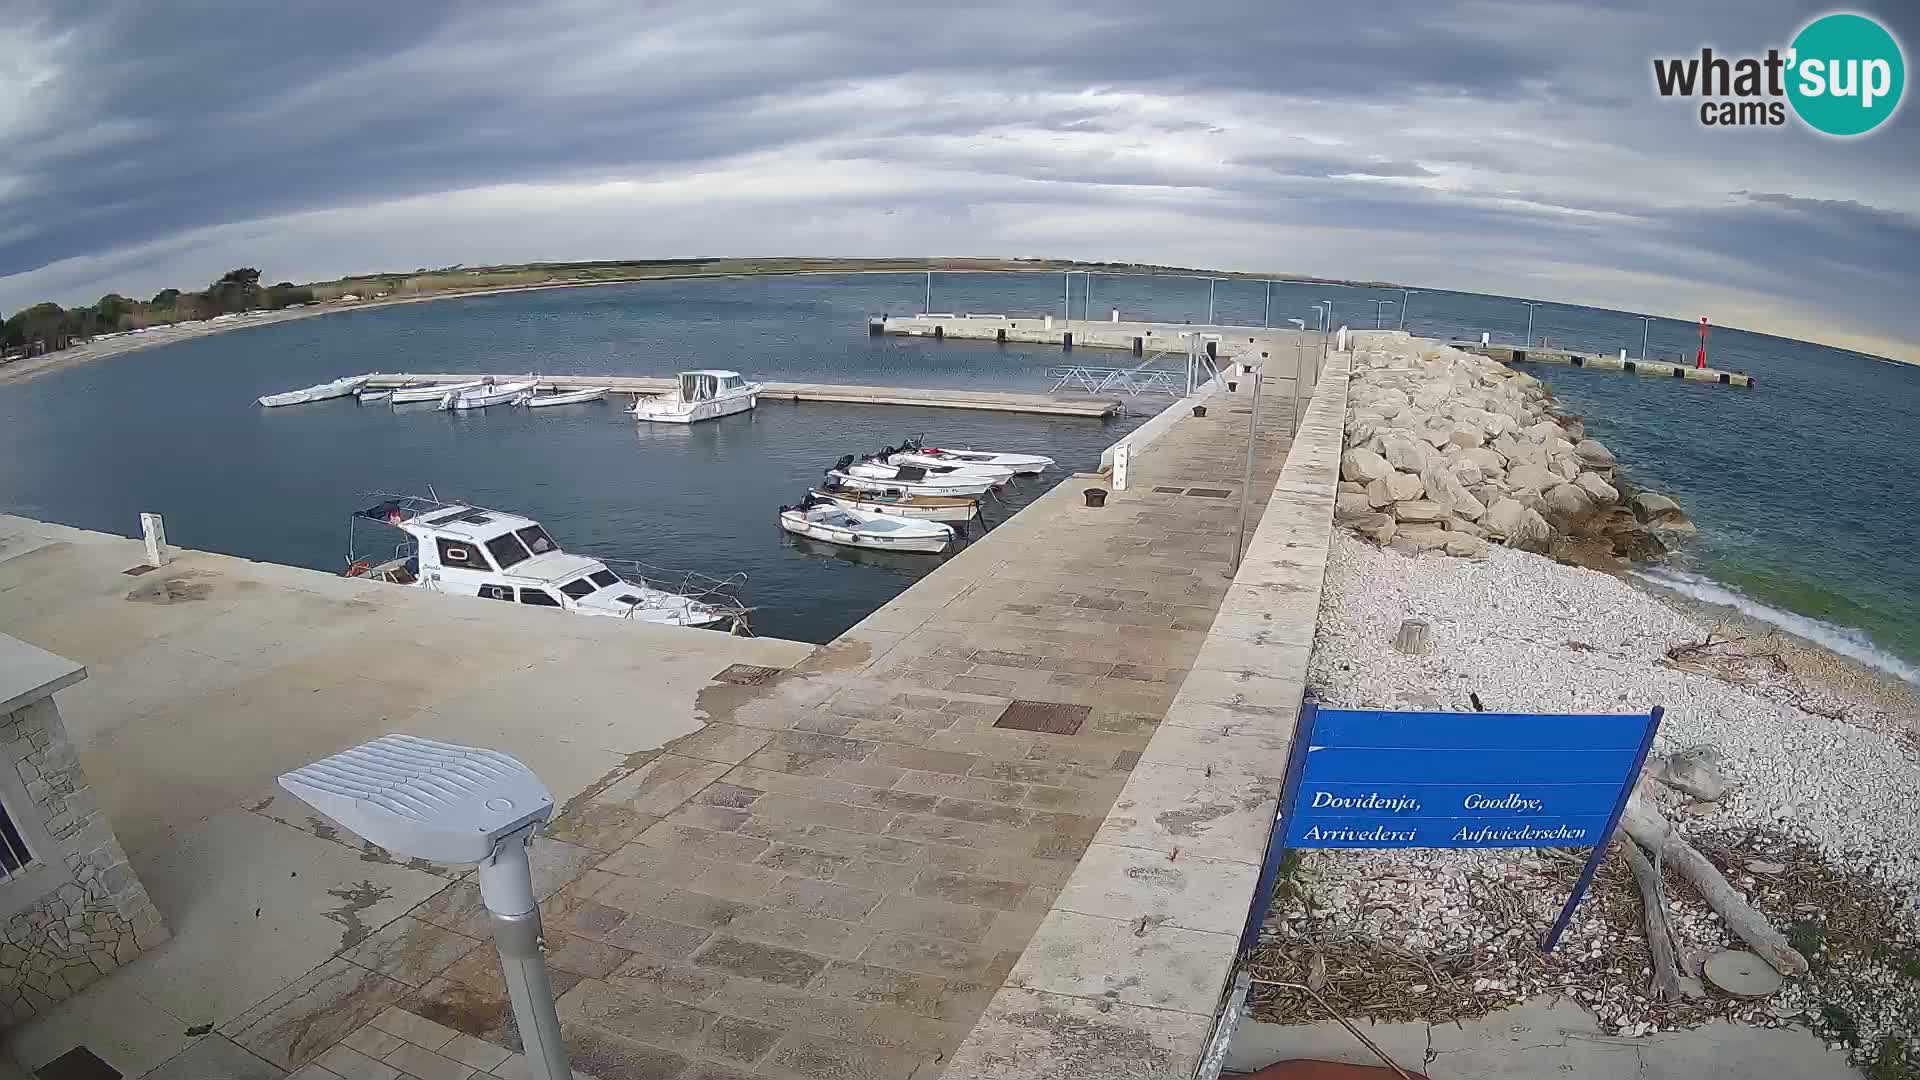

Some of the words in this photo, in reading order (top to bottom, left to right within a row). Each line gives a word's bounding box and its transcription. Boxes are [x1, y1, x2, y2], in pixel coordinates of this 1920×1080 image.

[1311, 791, 1422, 812] Doviđenja,
[1463, 793, 1544, 813] Goodbye,
[1303, 825, 1417, 841] Arrivederci
[1452, 824, 1586, 843] Aufwiedersehen
